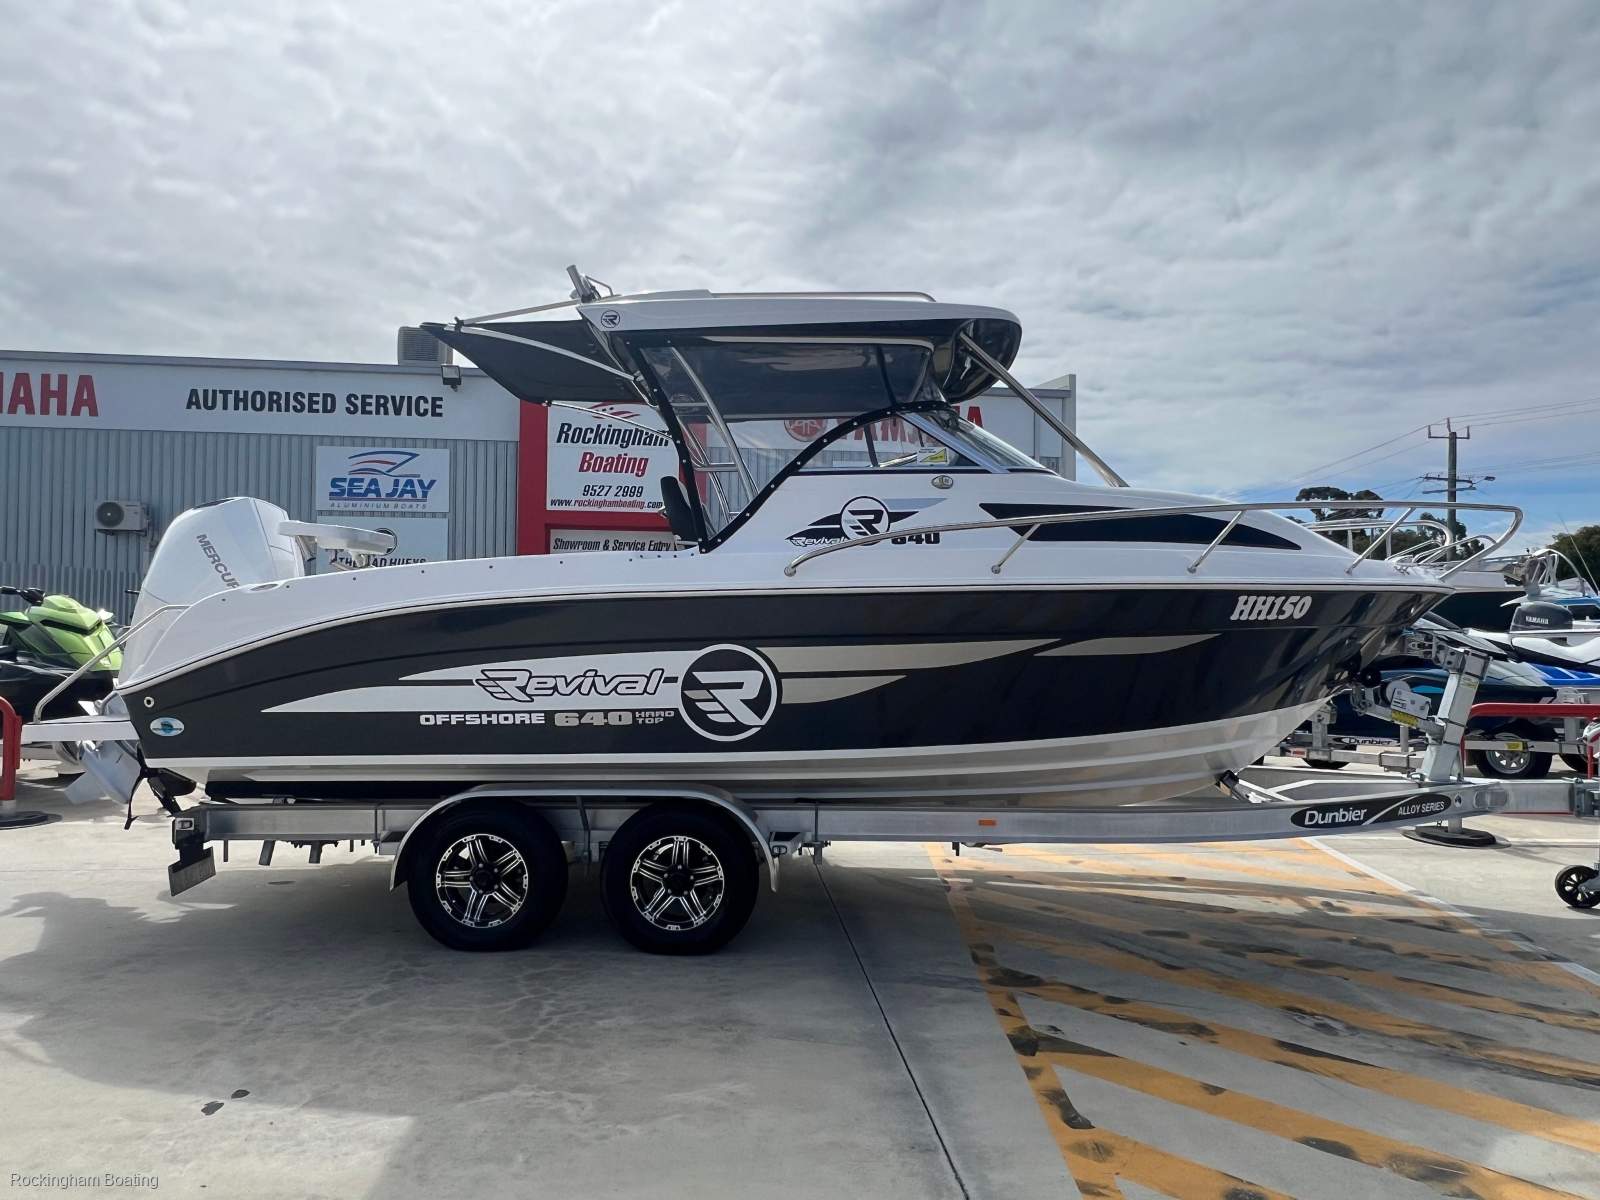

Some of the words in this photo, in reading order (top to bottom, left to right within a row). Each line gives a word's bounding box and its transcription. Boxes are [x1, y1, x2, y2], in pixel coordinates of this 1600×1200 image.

[0, 371, 99, 417] AHA
[186, 388, 337, 414] AUTHORISED
[345, 393, 444, 417] SERVICE
[556, 422, 670, 449] Rockingham
[578, 451, 649, 477] Boating
[328, 477, 382, 498] SEA
[385, 478, 437, 499] JAY
[582, 484, 611, 498] 9527
[330, 501, 390, 509] ALUMINIUM
[553, 538, 601, 551] Showroom
[602, 539, 610, 551] &
[612, 540, 646, 552] Service
[647, 541, 671, 552] Entry
[790, 536, 847, 548] Revival
[1230, 595, 1313, 621] HH150
[475, 668, 665, 703] Revival
[419, 712, 546, 726] OFFSHORE
[554, 711, 633, 727] 640
[635, 717, 664, 725] TOP
[1304, 807, 1367, 826] Dunbier
[1397, 803, 1422, 817] ALLOY
[1421, 800, 1446, 813] SERIES
